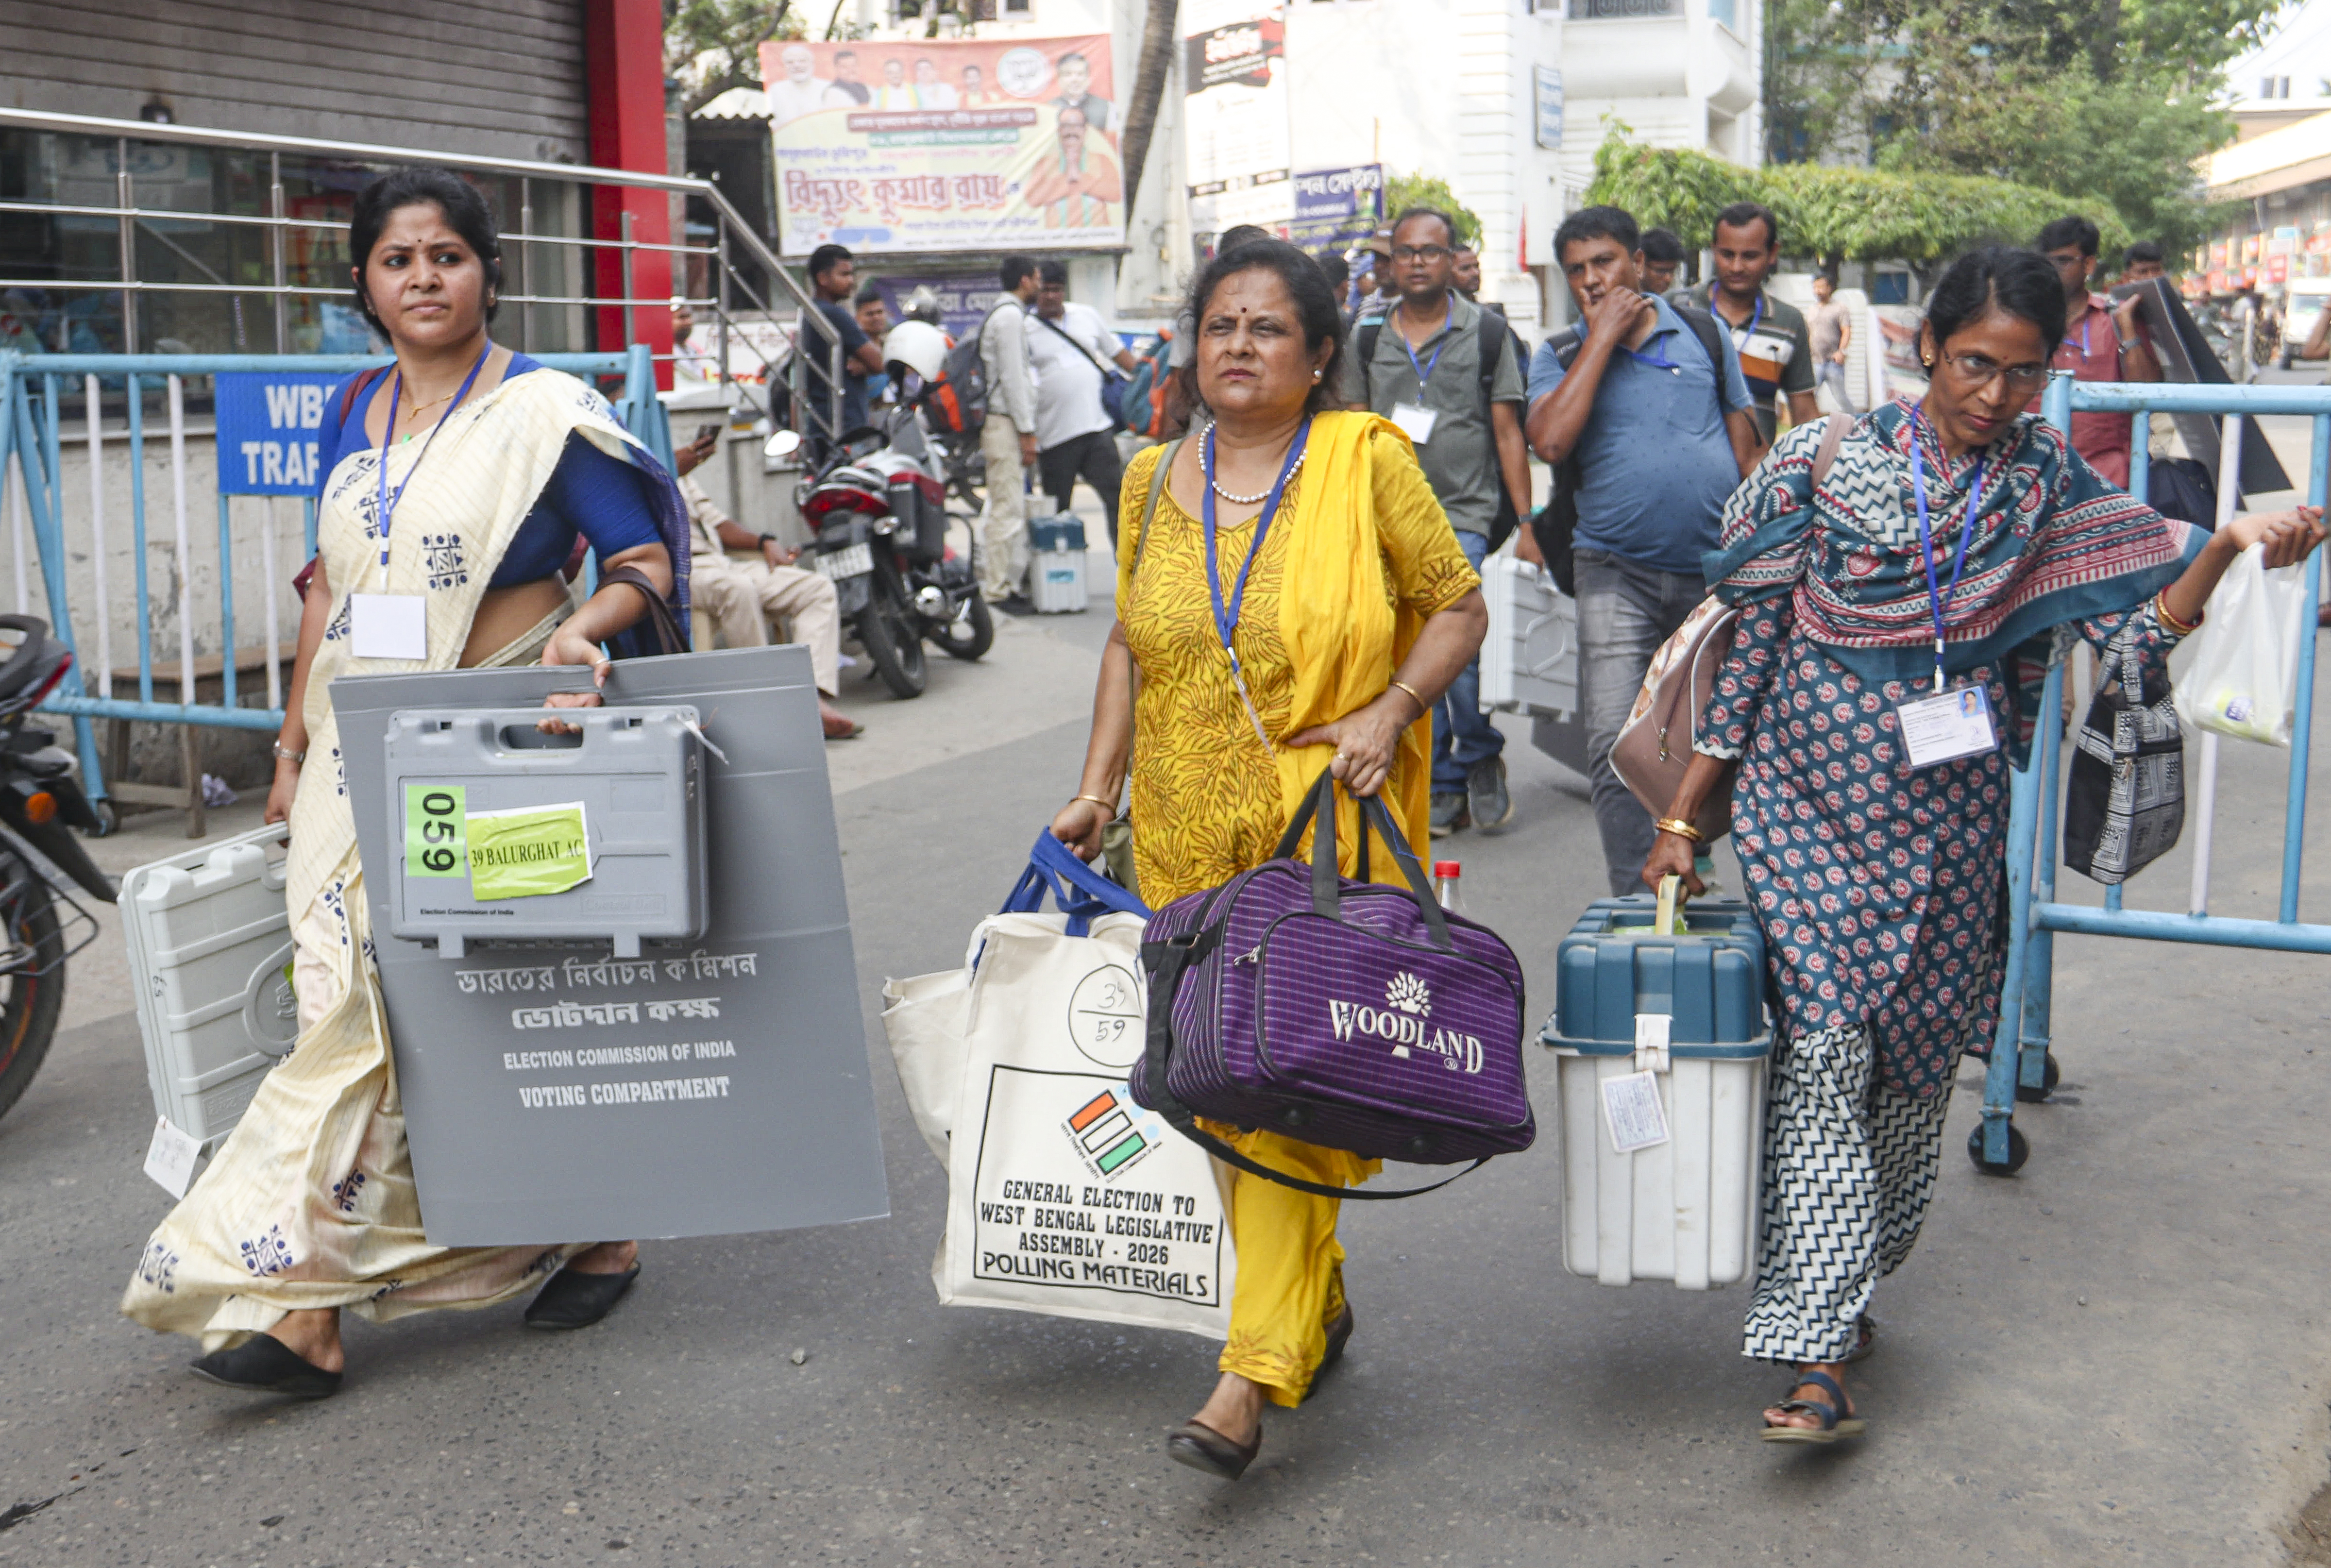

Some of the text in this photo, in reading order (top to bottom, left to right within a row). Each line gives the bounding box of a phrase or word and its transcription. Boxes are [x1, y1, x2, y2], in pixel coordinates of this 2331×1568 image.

[785, 169, 867, 221] বিদ্যুৎ
[870, 175, 948, 221] কুমার
[952, 173, 1001, 208] রায়
[1327, 168, 1381, 195] সেন্টার
[264, 384, 337, 429] WB
[422, 792, 455, 871] 059
[471, 839, 582, 867] 39 BALURGHAT AC
[455, 966, 556, 994] ভারতের
[561, 952, 655, 988] নির্বাচন
[511, 996, 721, 1029] ভোটদান কক্ষ
[1095, 1020, 1126, 1043] 59
[503, 1040, 736, 1070] ELECTION COMMISSION OF INDIA
[1328, 999, 1484, 1074] WOODLAND
[519, 1075, 729, 1108] VOTING COMPARTMENT
[1105, 1169, 1124, 1183] ELECTION
[1124, 1153, 1147, 1171] COMMISSION
[1152, 1140, 1162, 1150] INDIA
[1003, 1179, 1195, 1216] GENERAL ELECTION TO
[980, 1201, 1213, 1243] WEST BENGAL LEGISLATIVE
[1019, 1231, 1104, 1258] ASSEMBLY
[1127, 1242, 1169, 1265] 2026
[983, 1250, 1208, 1297] POLLING MATERIALS
